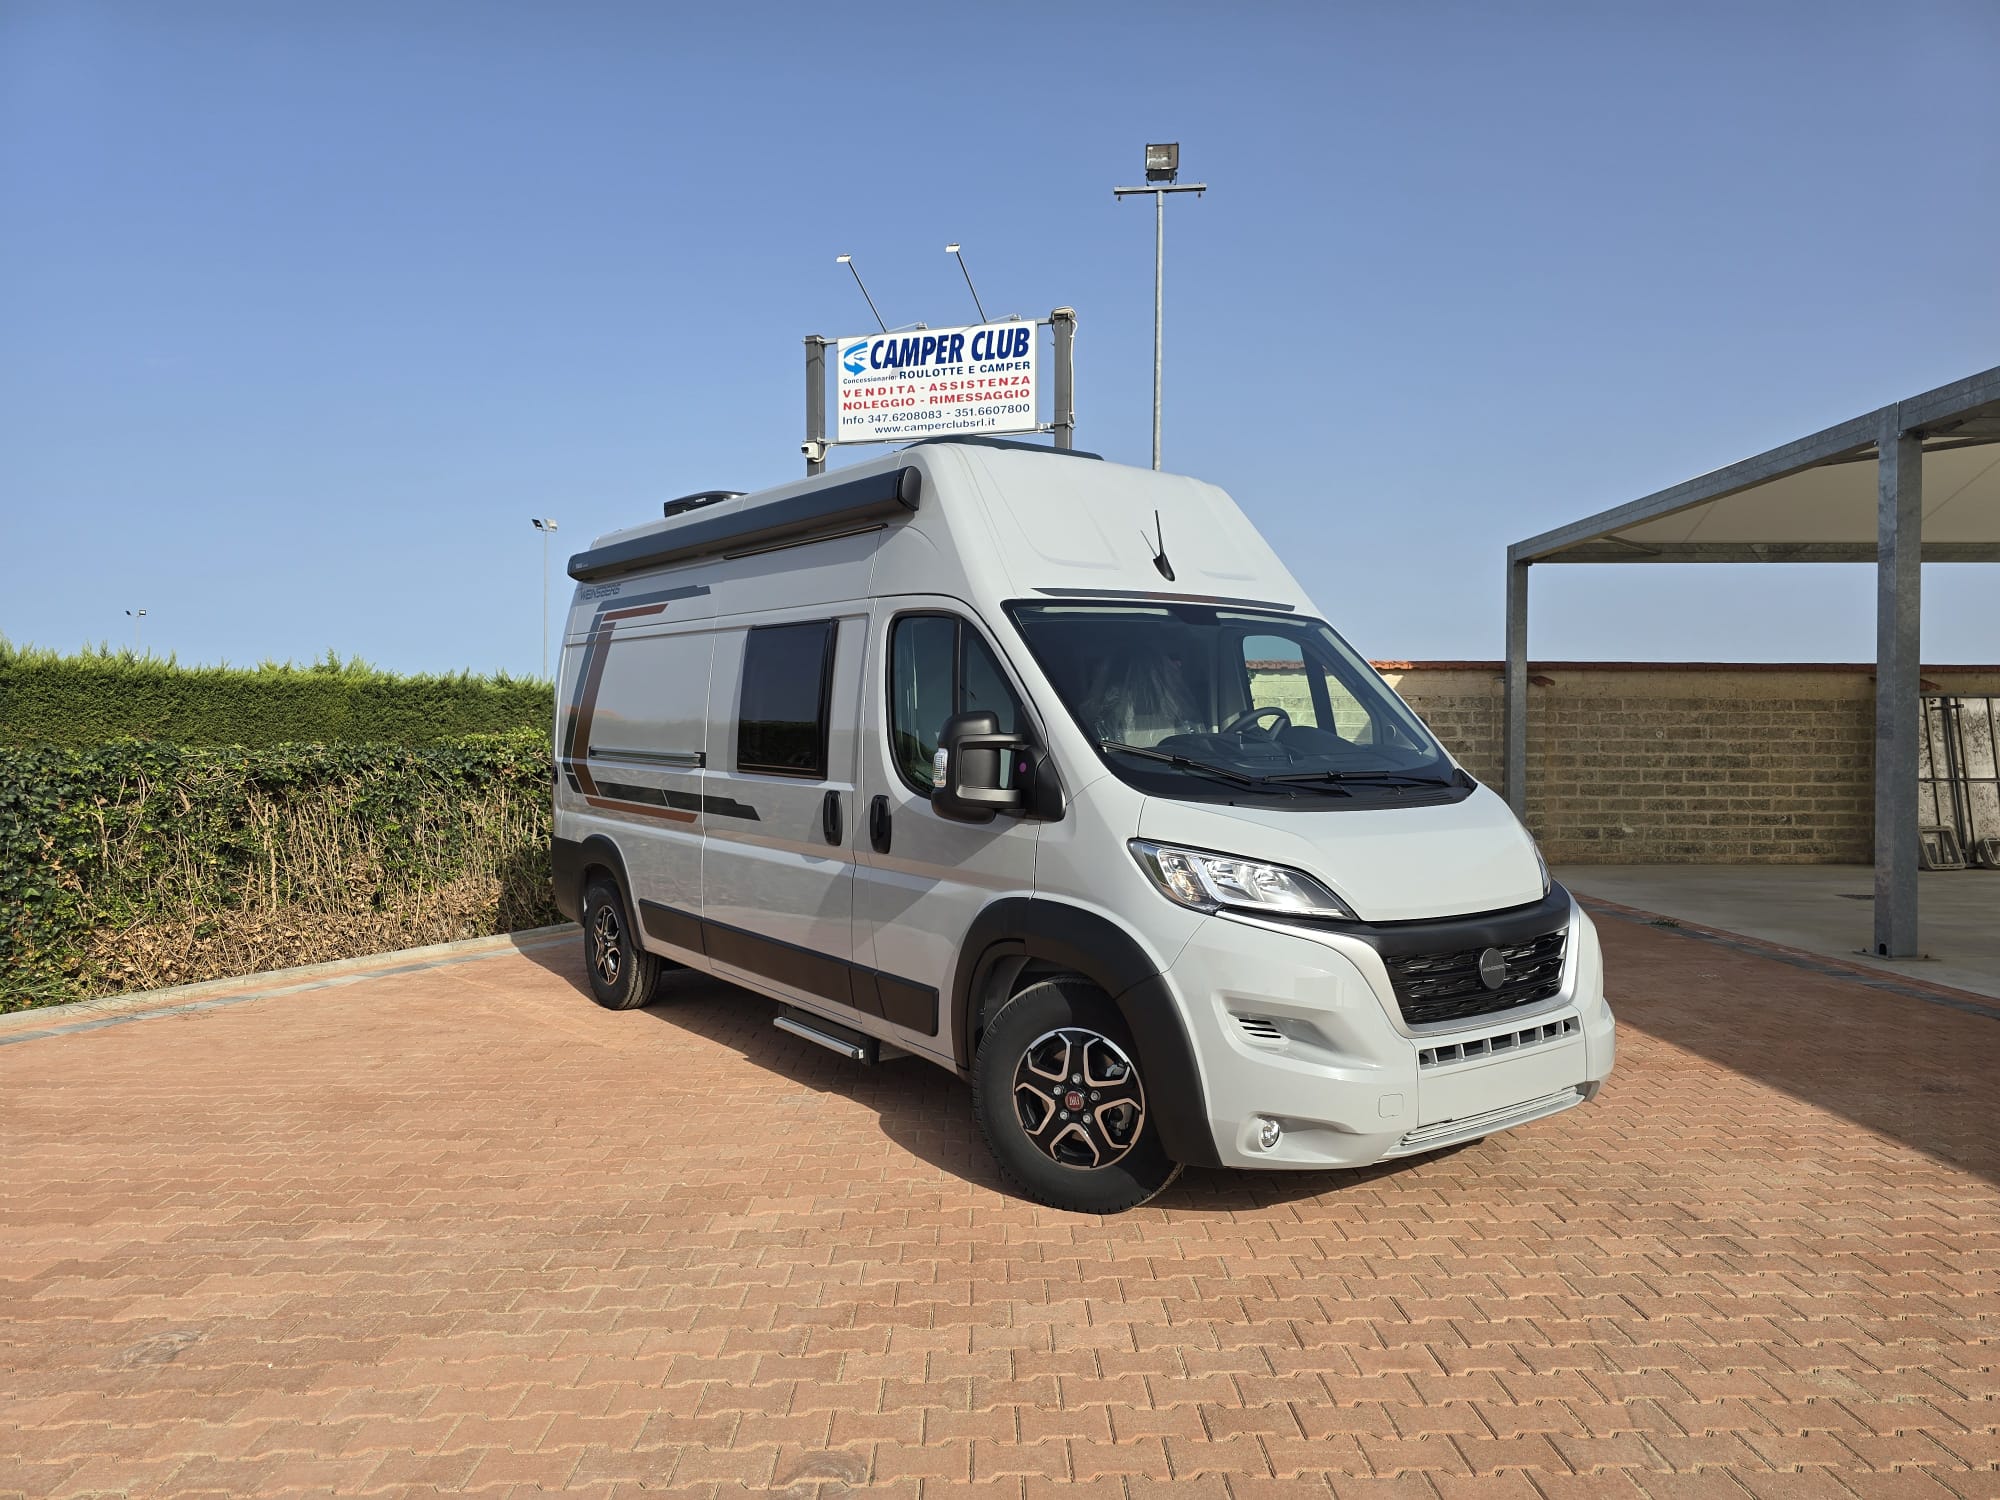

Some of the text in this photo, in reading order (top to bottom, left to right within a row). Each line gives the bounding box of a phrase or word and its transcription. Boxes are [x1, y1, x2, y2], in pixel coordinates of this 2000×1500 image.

[870, 328, 1031, 370] CAMPER CLUB
[899, 366, 964, 380] ROULOTTE
[968, 365, 975, 374] E
[980, 361, 1031, 374] CAMPER
[842, 385, 916, 399] VENDITA
[929, 375, 1031, 392] ASSISTENZA
[843, 397, 916, 411] NOLEGGIO
[929, 388, 1030, 405] RIMESSAGGIO
[842, 415, 864, 425] Info
[868, 410, 942, 424] 347.6208083
[955, 403, 1030, 418] 351.6607800
[874, 418, 996, 434] www.camperclubsrl.it
